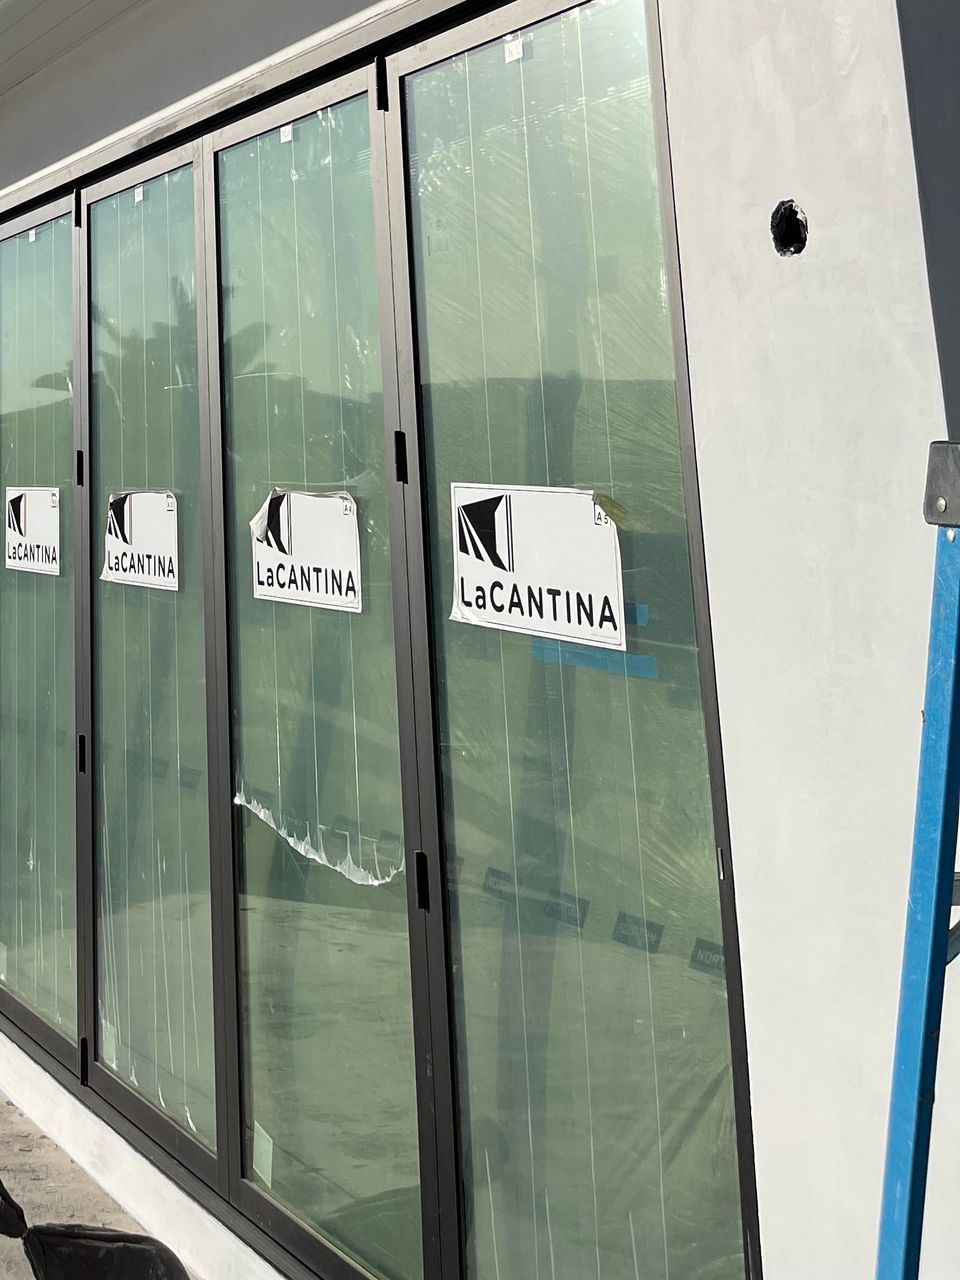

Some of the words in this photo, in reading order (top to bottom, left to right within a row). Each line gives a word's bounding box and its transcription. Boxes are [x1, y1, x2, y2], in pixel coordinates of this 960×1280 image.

[7, 542, 58, 565] LaCANTINA
[107, 550, 175, 579] LaCANTINA
[256, 561, 357, 598] LaCANTINA
[460, 576, 618, 632] LaCANTINA
